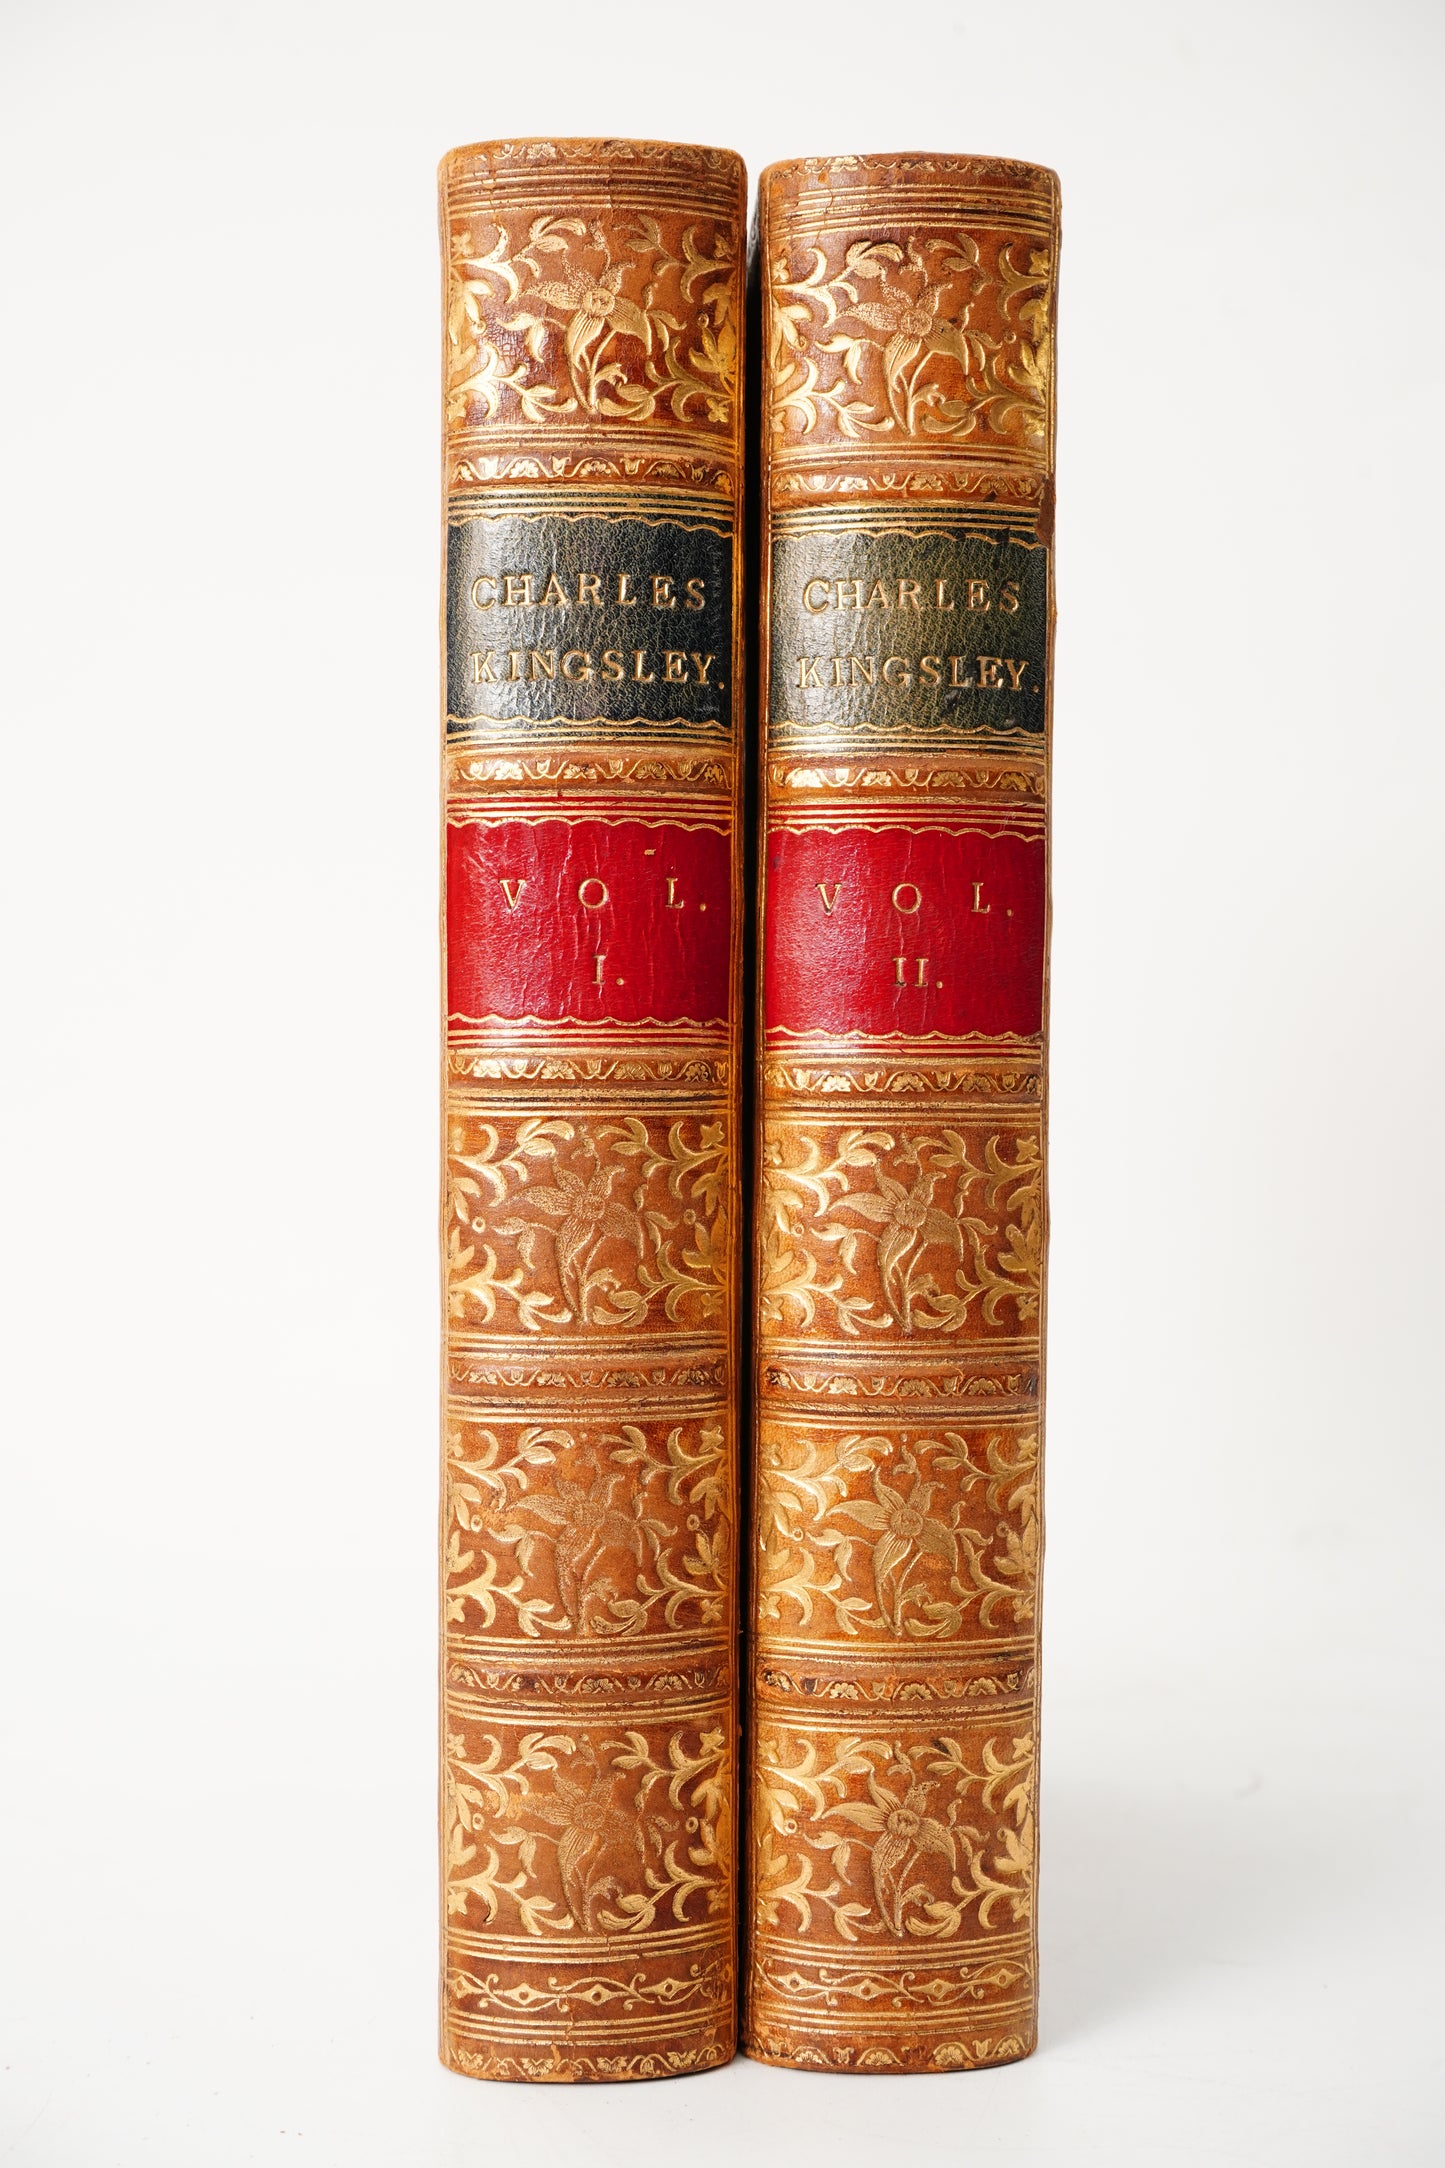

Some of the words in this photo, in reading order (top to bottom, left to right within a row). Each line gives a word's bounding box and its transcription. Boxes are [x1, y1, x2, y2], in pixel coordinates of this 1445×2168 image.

[471, 573, 706, 611] CHARLES
[803, 578, 1020, 615] CHARLES
[470, 650, 725, 690] KINGSLEY.
[797, 655, 1039, 693] KINGSLEY.
[592, 954, 624, 985] I.
[893, 956, 943, 989] II.
